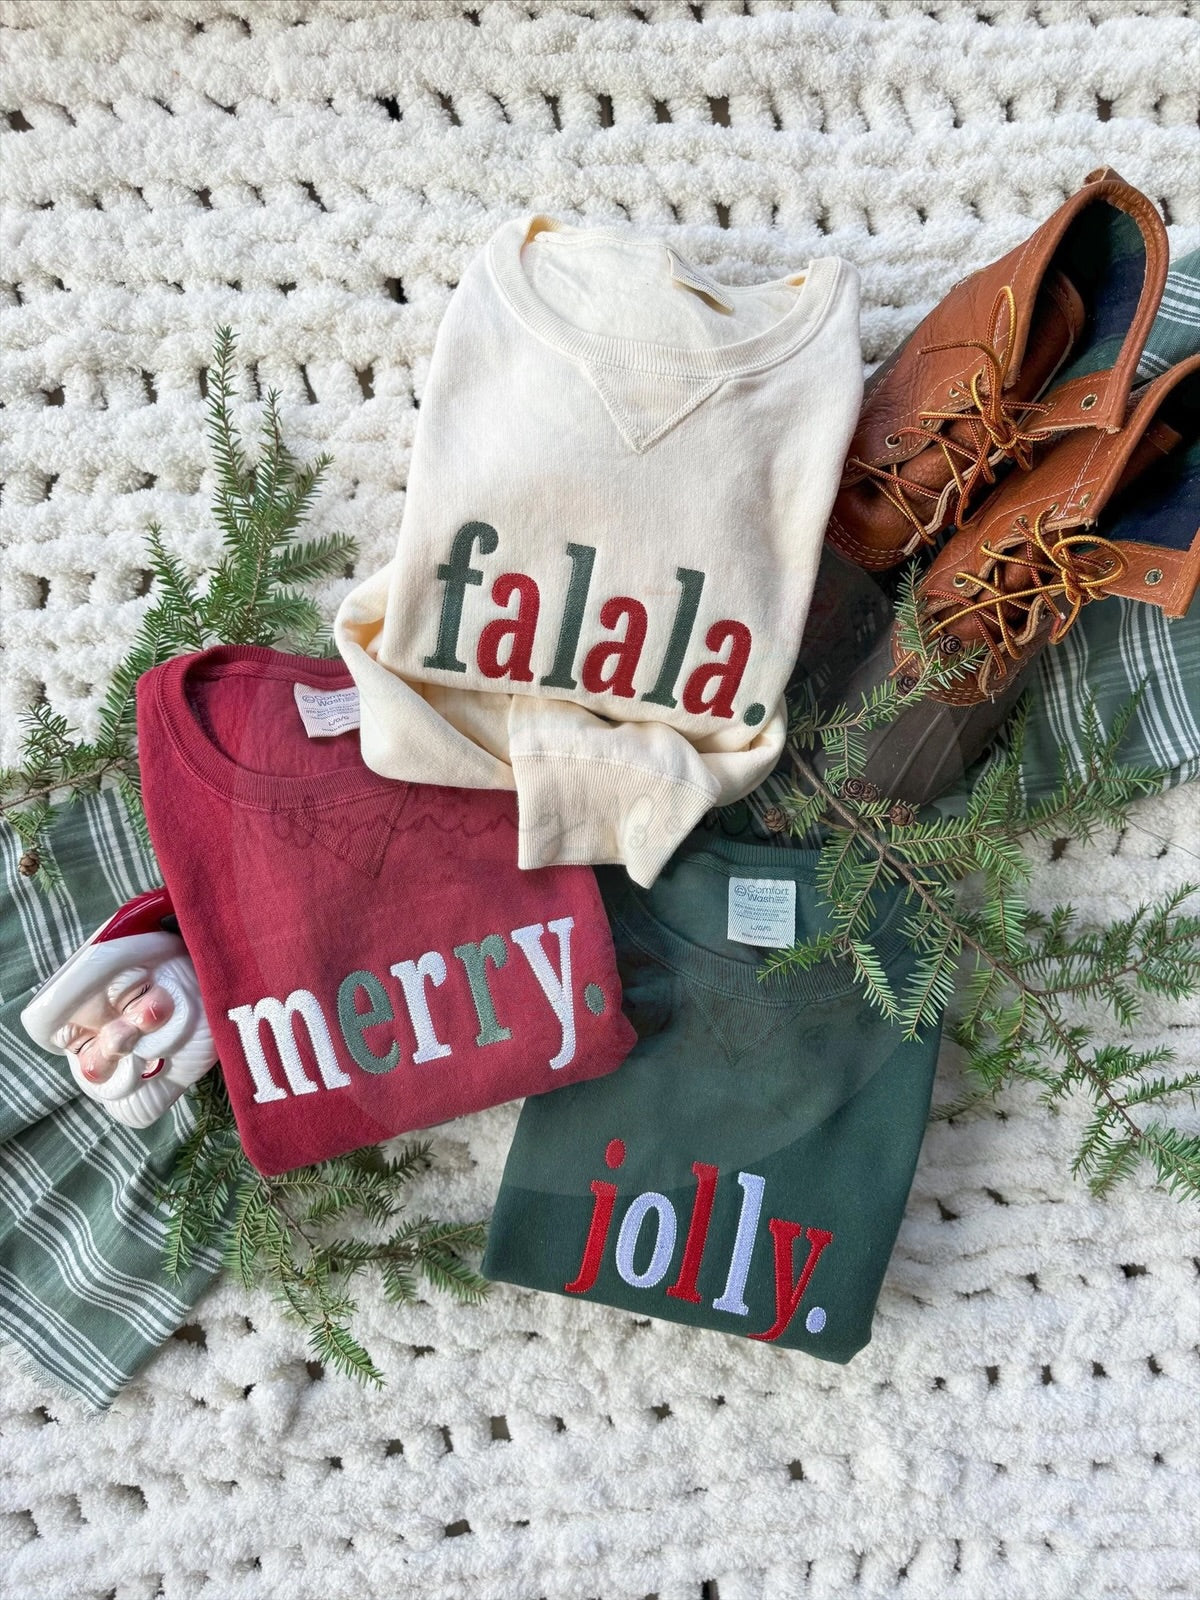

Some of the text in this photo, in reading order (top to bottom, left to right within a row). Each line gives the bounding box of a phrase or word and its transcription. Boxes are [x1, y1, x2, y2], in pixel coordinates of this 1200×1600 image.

[424, 521, 766, 726] falala.
[746, 884, 790, 896] Comfort
[747, 893, 775, 903] Wash
[228, 916, 605, 1103] merry.
[564, 1138, 833, 1341] jolly.
